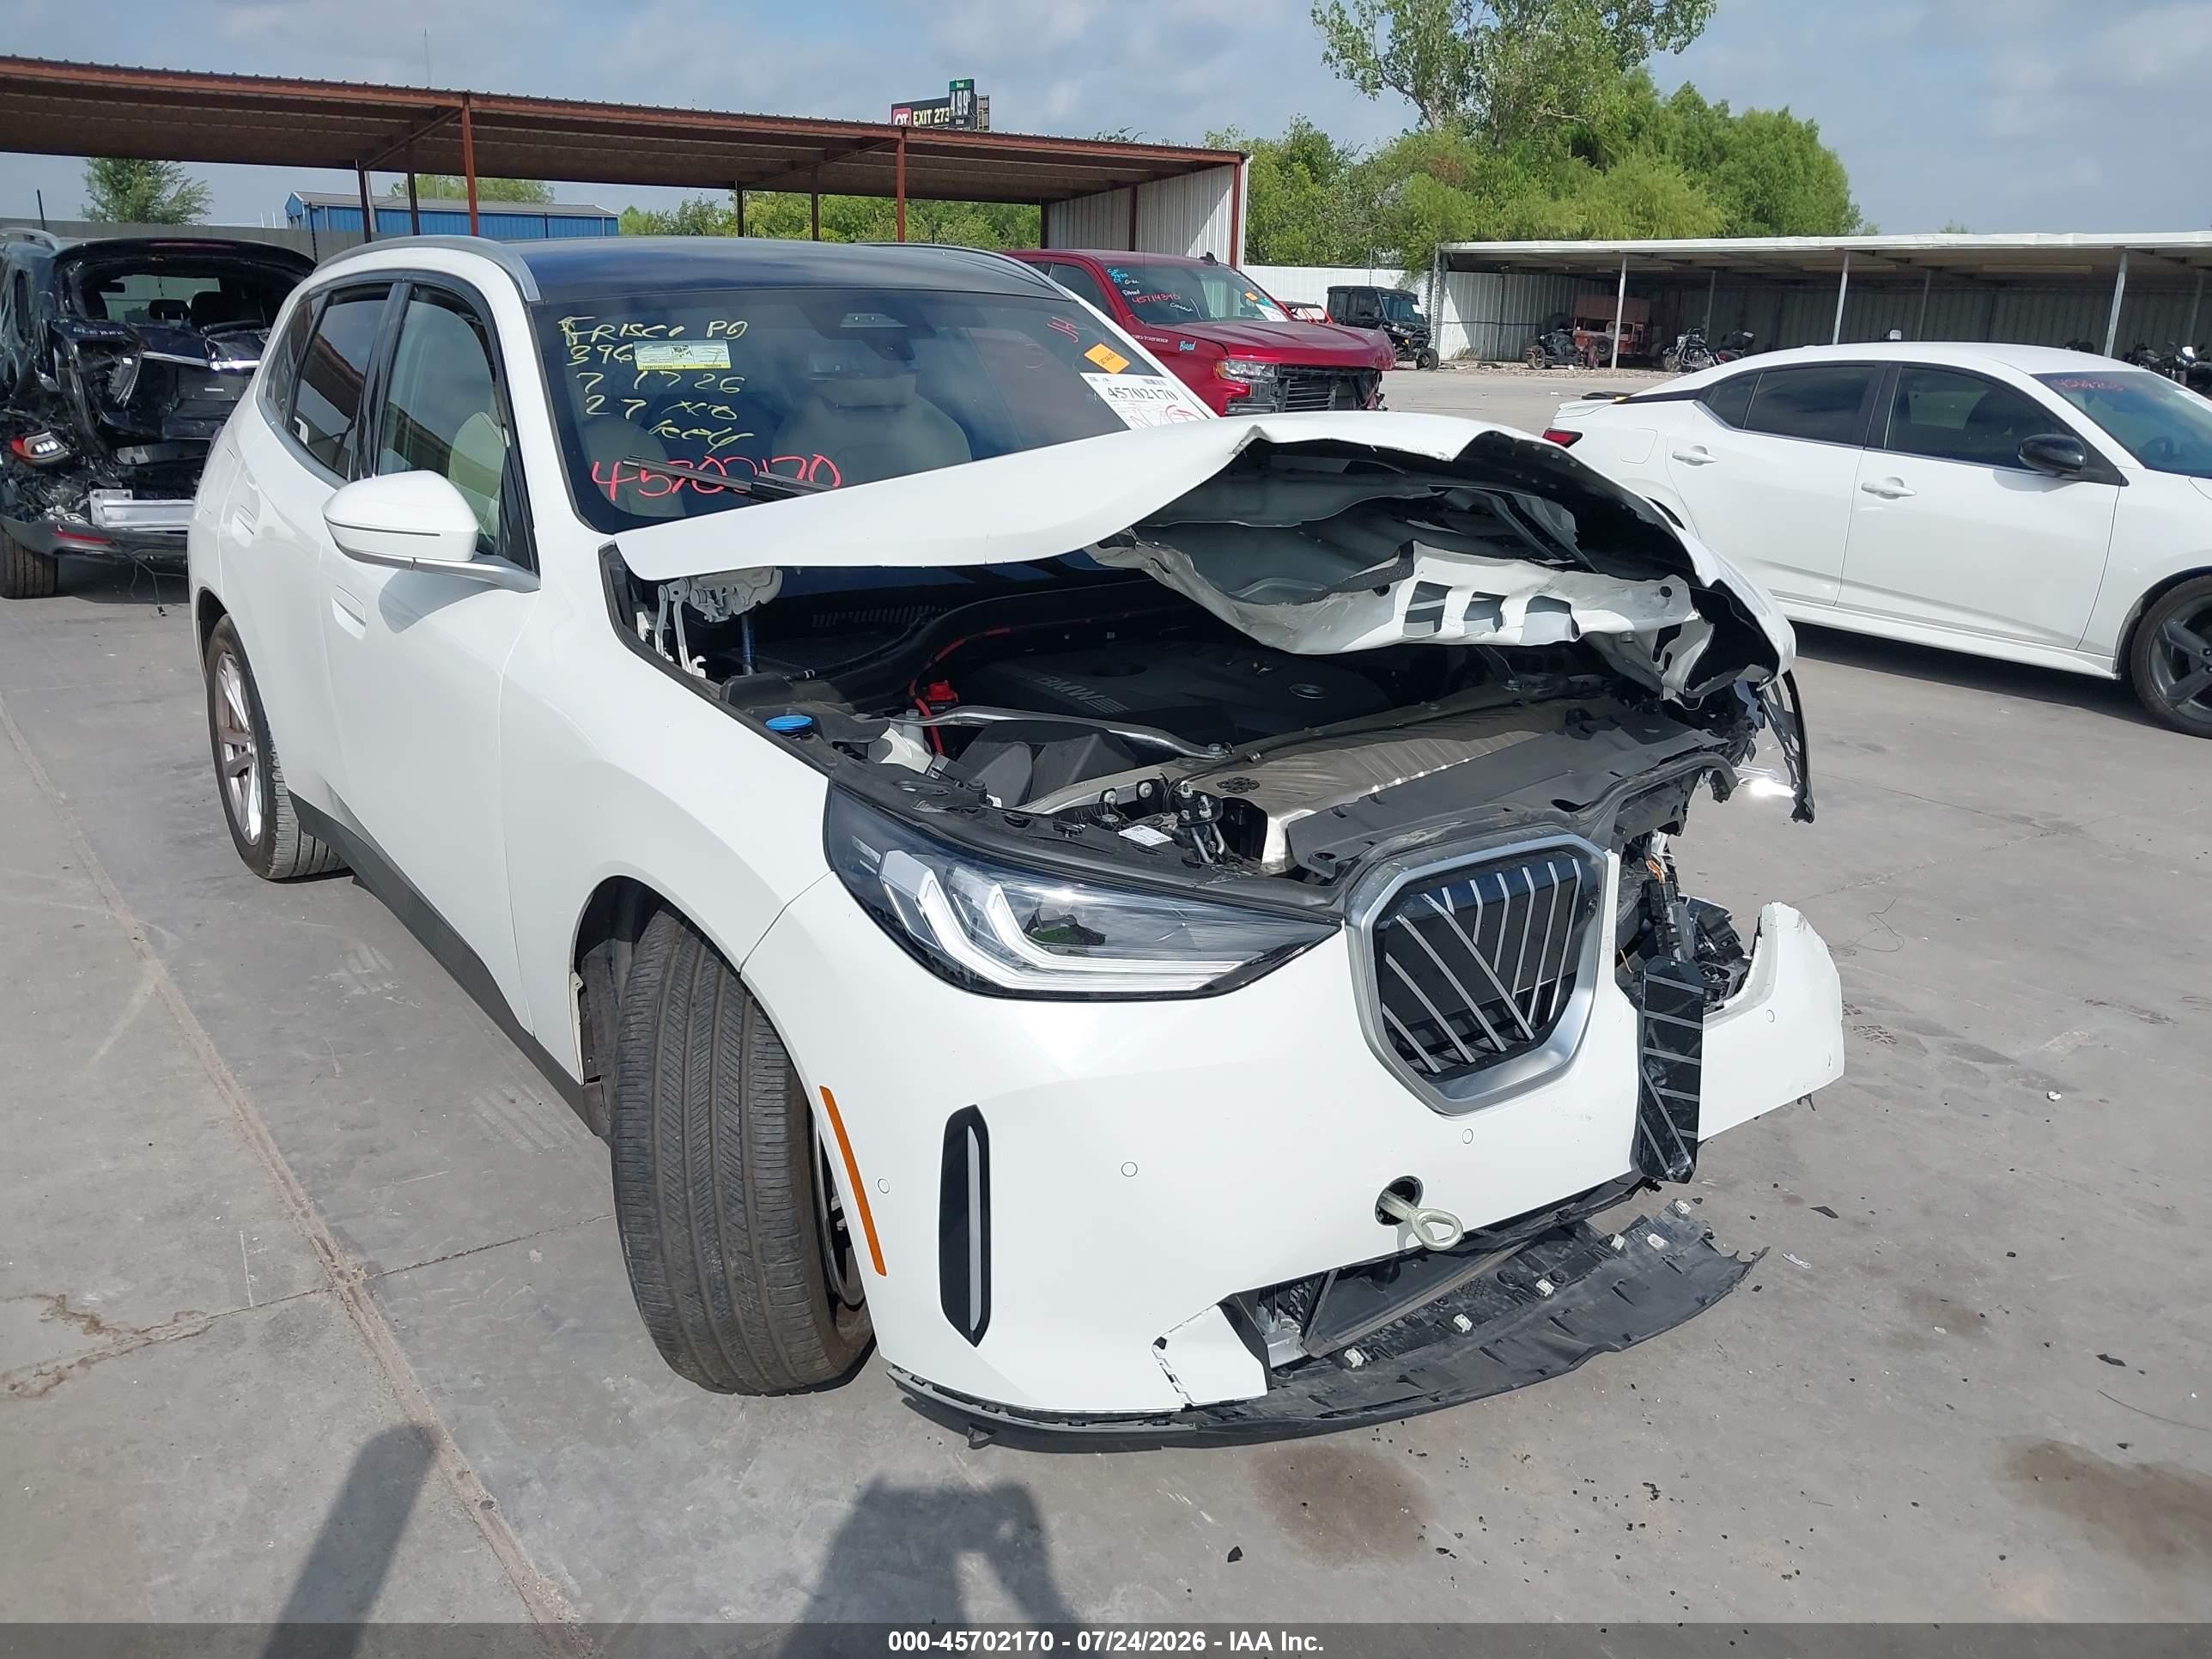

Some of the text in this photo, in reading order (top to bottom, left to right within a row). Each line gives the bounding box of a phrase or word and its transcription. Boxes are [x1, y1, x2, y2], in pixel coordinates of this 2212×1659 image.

[913, 109, 933, 125] EXIT
[933, 106, 949, 124] 273
[1107, 386, 1180, 401] 45702170
[1033, 675, 1106, 701] BMW
